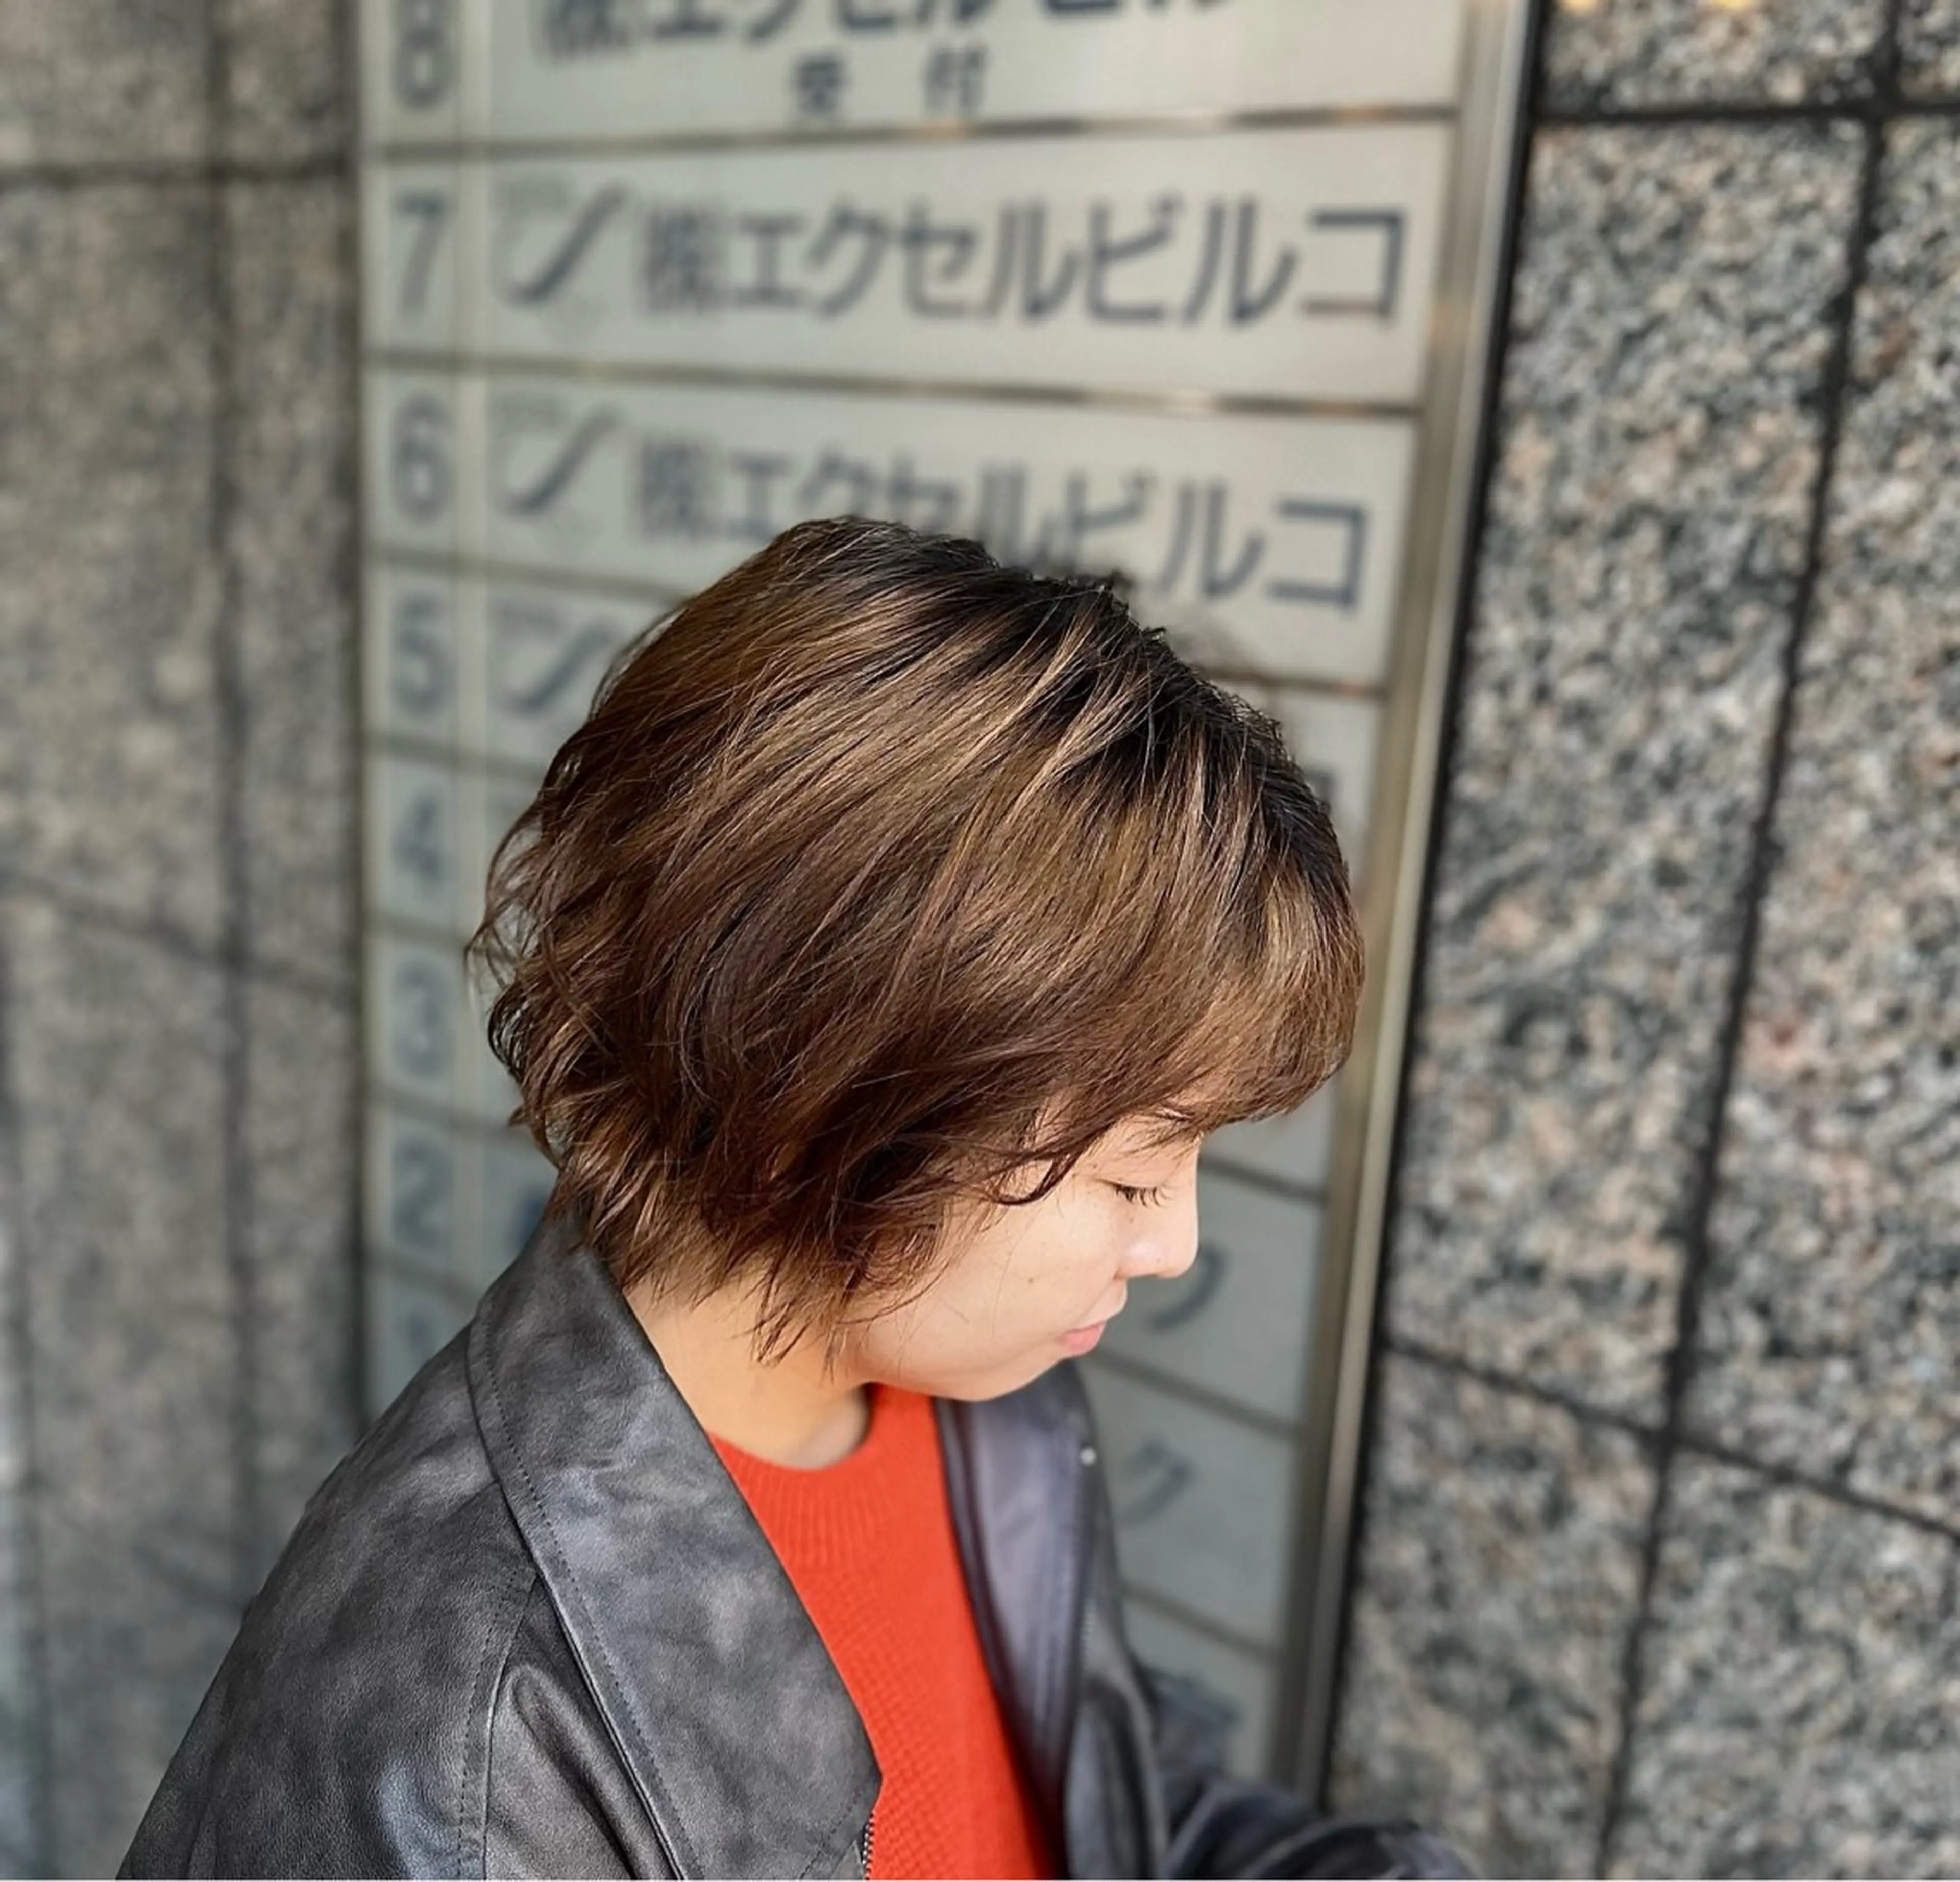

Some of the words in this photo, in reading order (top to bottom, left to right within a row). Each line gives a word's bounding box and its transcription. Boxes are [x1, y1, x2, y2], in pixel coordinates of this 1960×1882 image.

[397, 195, 450, 320] 7
[394, 395, 453, 522] 6
[392, 596, 453, 715] 5
[390, 790, 449, 896] 4
[391, 959, 454, 1078] 3
[391, 1136, 454, 1253] 2
